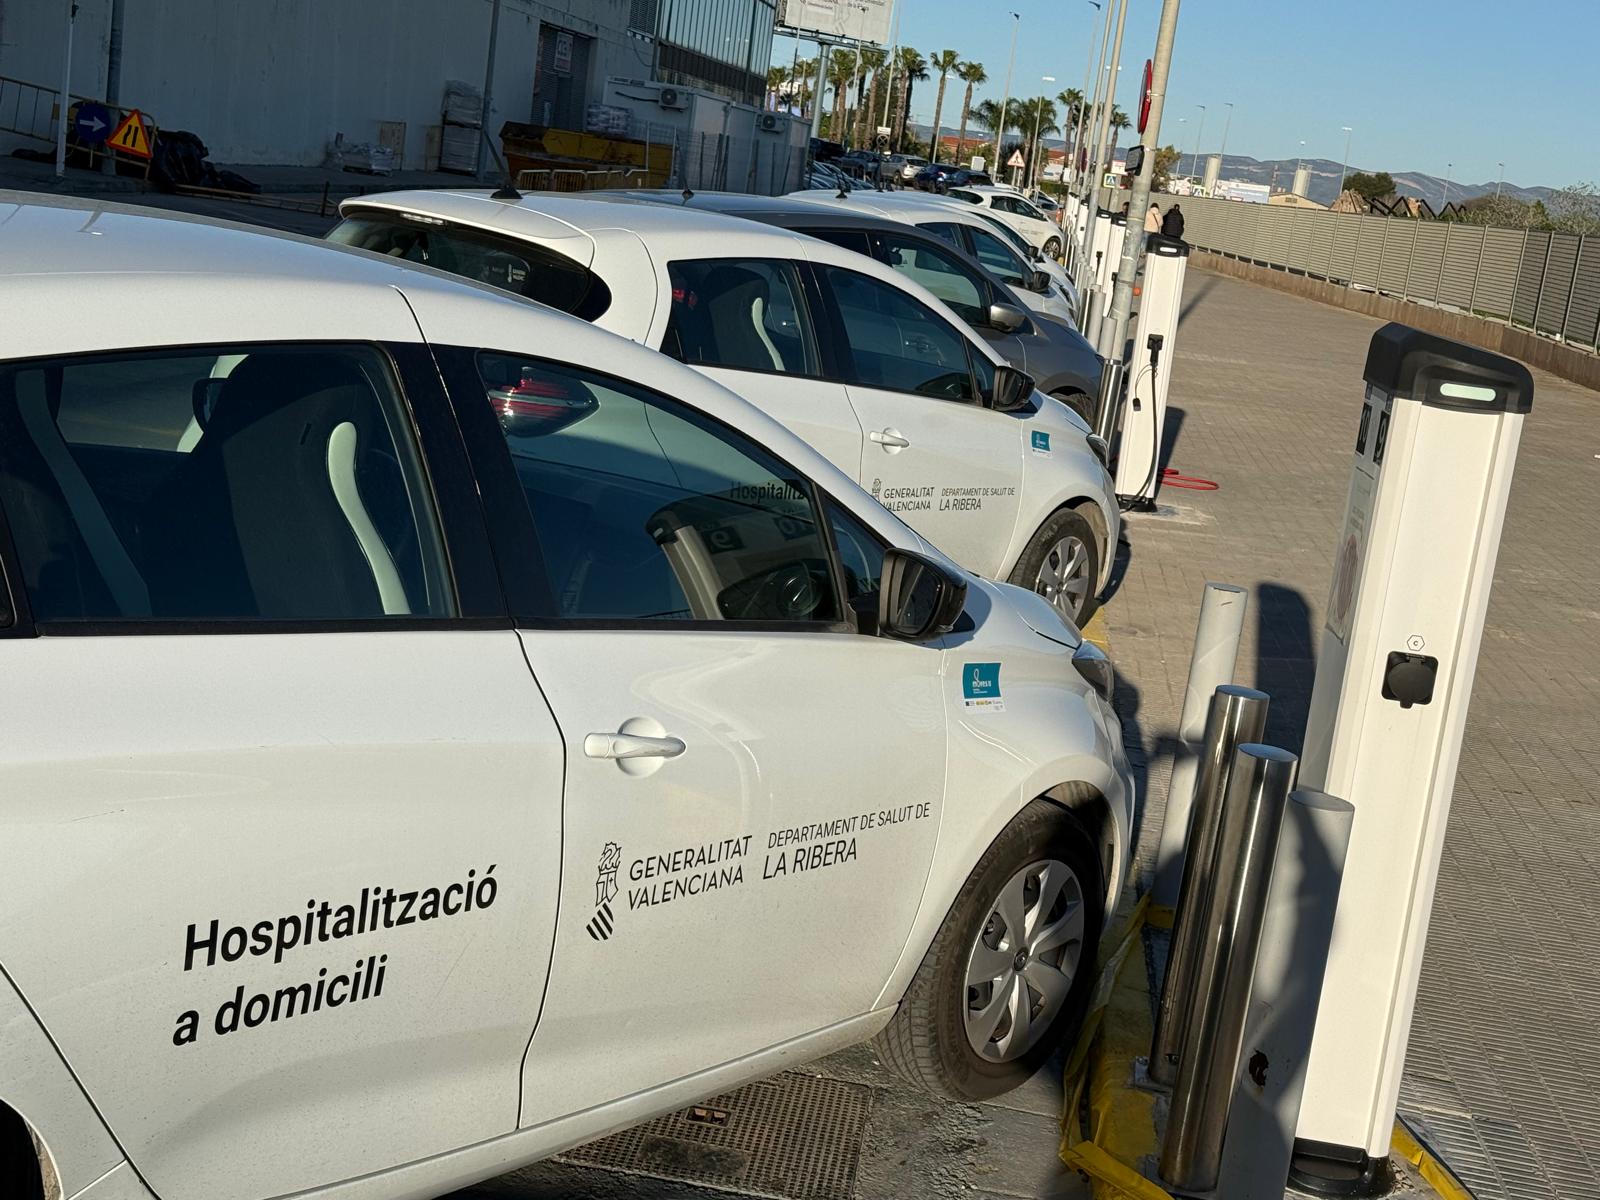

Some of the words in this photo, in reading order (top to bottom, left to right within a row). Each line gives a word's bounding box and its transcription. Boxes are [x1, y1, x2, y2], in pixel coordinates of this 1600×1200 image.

[1376, 417, 1388, 459] 9
[884, 487, 935, 499] GENERALITAT
[939, 499, 950, 511] LA
[952, 498, 982, 511] RIBERA
[941, 488, 982, 497] DEPARTAMENT
[982, 488, 990, 496] DE
[990, 488, 1007, 496] SALUT
[1007, 487, 1016, 496] DE
[767, 816, 859, 850] DEPARTAMENT
[859, 812, 877, 831] DE
[877, 804, 915, 827] SALUT
[915, 801, 931, 819] DE
[629, 836, 753, 882] GENERALITAT
[762, 851, 787, 881] LA
[792, 837, 857, 874] RIBERA
[628, 863, 744, 912] VALENCIANA
[184, 863, 498, 972] Hospitalització
[172, 1009, 200, 1047] a
[214, 953, 388, 1036] domicili
